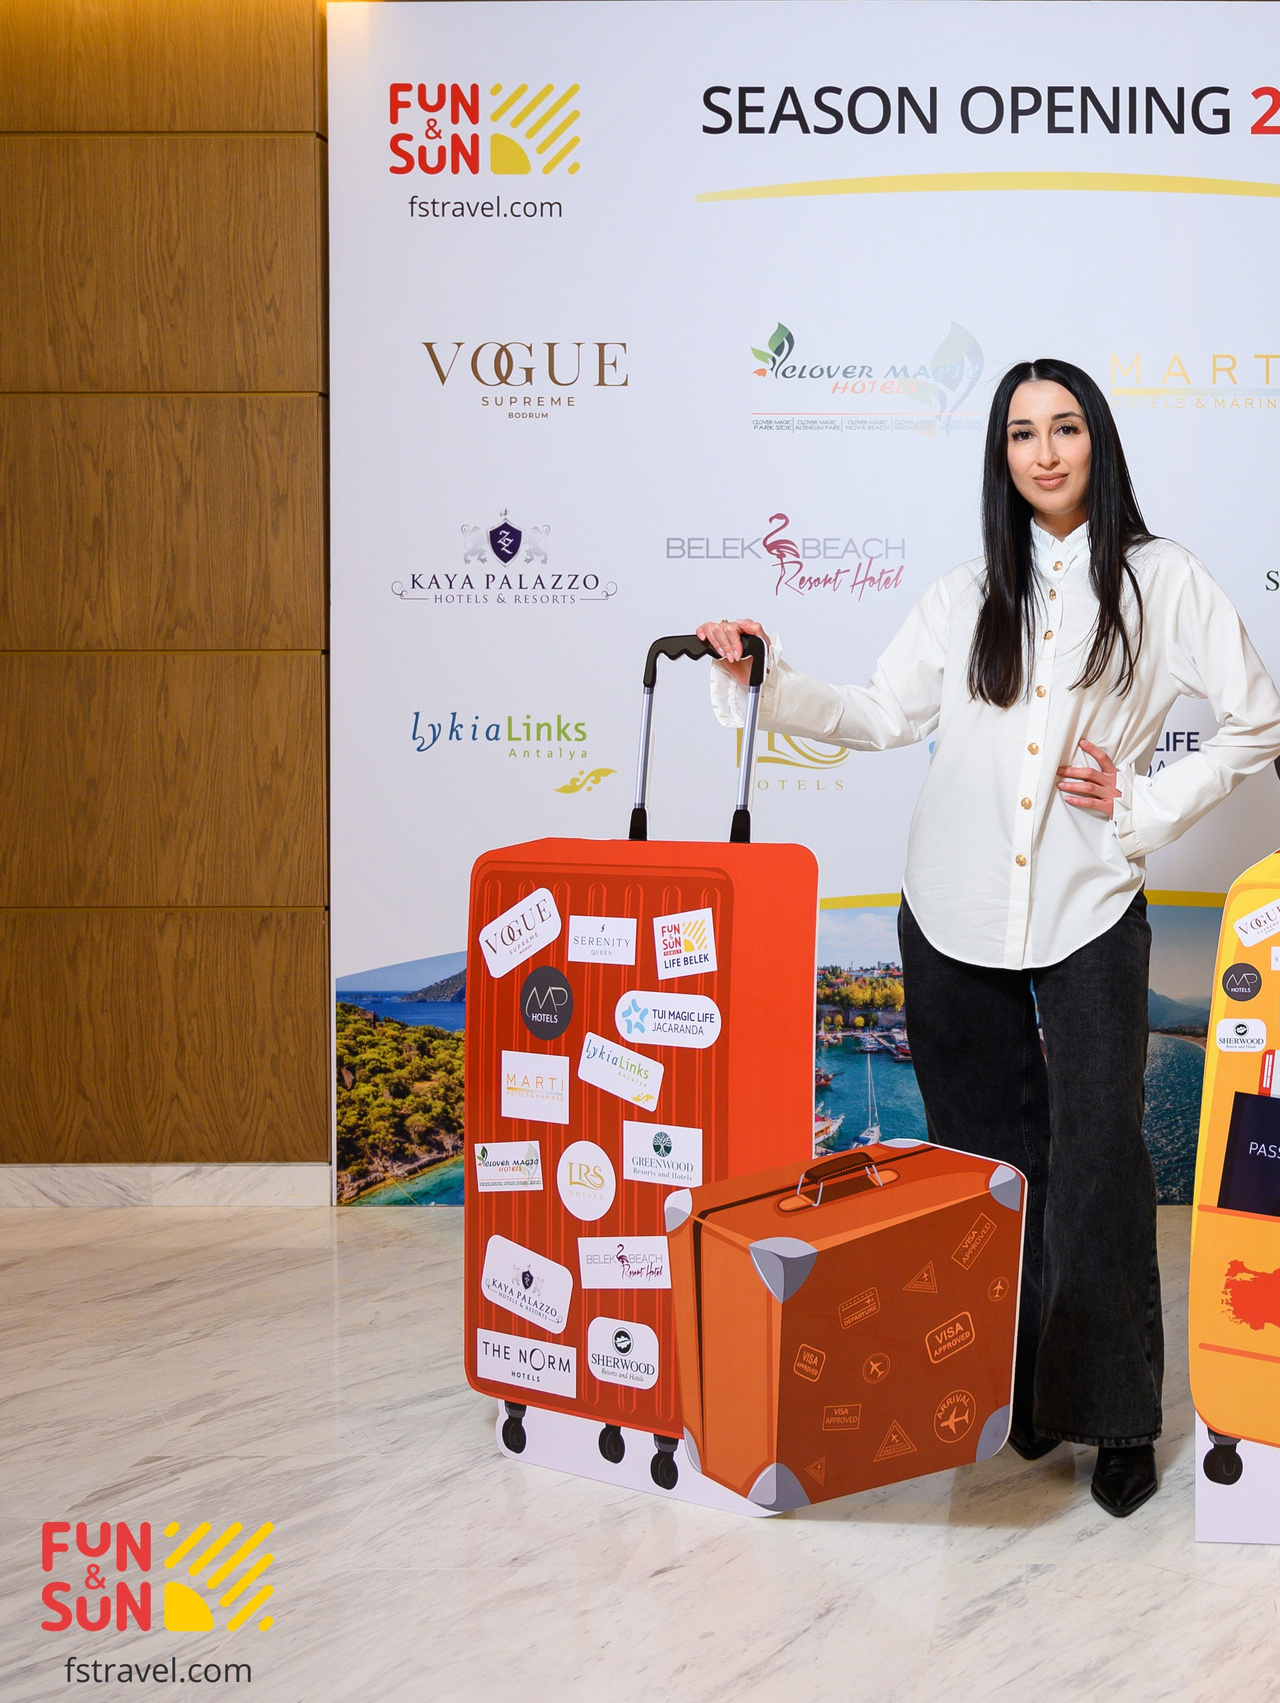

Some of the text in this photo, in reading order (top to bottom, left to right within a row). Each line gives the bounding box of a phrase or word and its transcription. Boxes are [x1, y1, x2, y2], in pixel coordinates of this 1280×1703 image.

[390, 83, 479, 125] FUN
[701, 86, 938, 135] SEASON
[960, 86, 1230, 135] OPENING
[425, 118, 442, 140] &
[390, 133, 479, 174] SUN
[409, 196, 562, 217] fstravel.com
[421, 342, 628, 386] VOGUE
[782, 365, 873, 379] CLOVER
[481, 397, 575, 406] SUPREME
[1196, 398, 1205, 408] &
[666, 538, 905, 559] BELEK BEACH
[410, 574, 599, 590] KAYA PALAZZO
[772, 557, 904, 601] Resort Hotel
[434, 593, 576, 604] HOTELS & RESORTS
[509, 748, 587, 760] Antalya
[758, 780, 844, 791] OTELS
[485, 899, 552, 956] VOGUE
[661, 923, 680, 937] FUN
[573, 936, 631, 947] SERENITY
[663, 937, 681, 950] SUN
[664, 953, 709, 969] LIFE BELEK
[532, 1013, 558, 1023] HOTELS
[652, 1009, 715, 1023] TUI MAGIC LIFE
[652, 1022, 704, 1035] JACARANDA
[506, 1073, 564, 1091] MARTI
[632, 1156, 693, 1172] GREENWOOD
[568, 1162, 605, 1190] LRS
[633, 1168, 656, 1177] Resorts
[672, 1172, 692, 1181] Hotels
[962, 1230, 979, 1249] VISA
[962, 1222, 991, 1263] APPROVED
[586, 1254, 663, 1264] BELEK BEACH
[492, 1278, 558, 1317] KAYA PALAZZO
[844, 1305, 877, 1326] DEPARTURE
[935, 1322, 964, 1344] VISA
[933, 1330, 971, 1357] APPROVED
[483, 1341, 571, 1373] THE NORM
[591, 1353, 655, 1376] SHERWOOD
[803, 1351, 819, 1366] VISA
[512, 1371, 540, 1383] HOTELS
[937, 1393, 970, 1419] ARRIVAL
[825, 1416, 857, 1424] APPROVED
